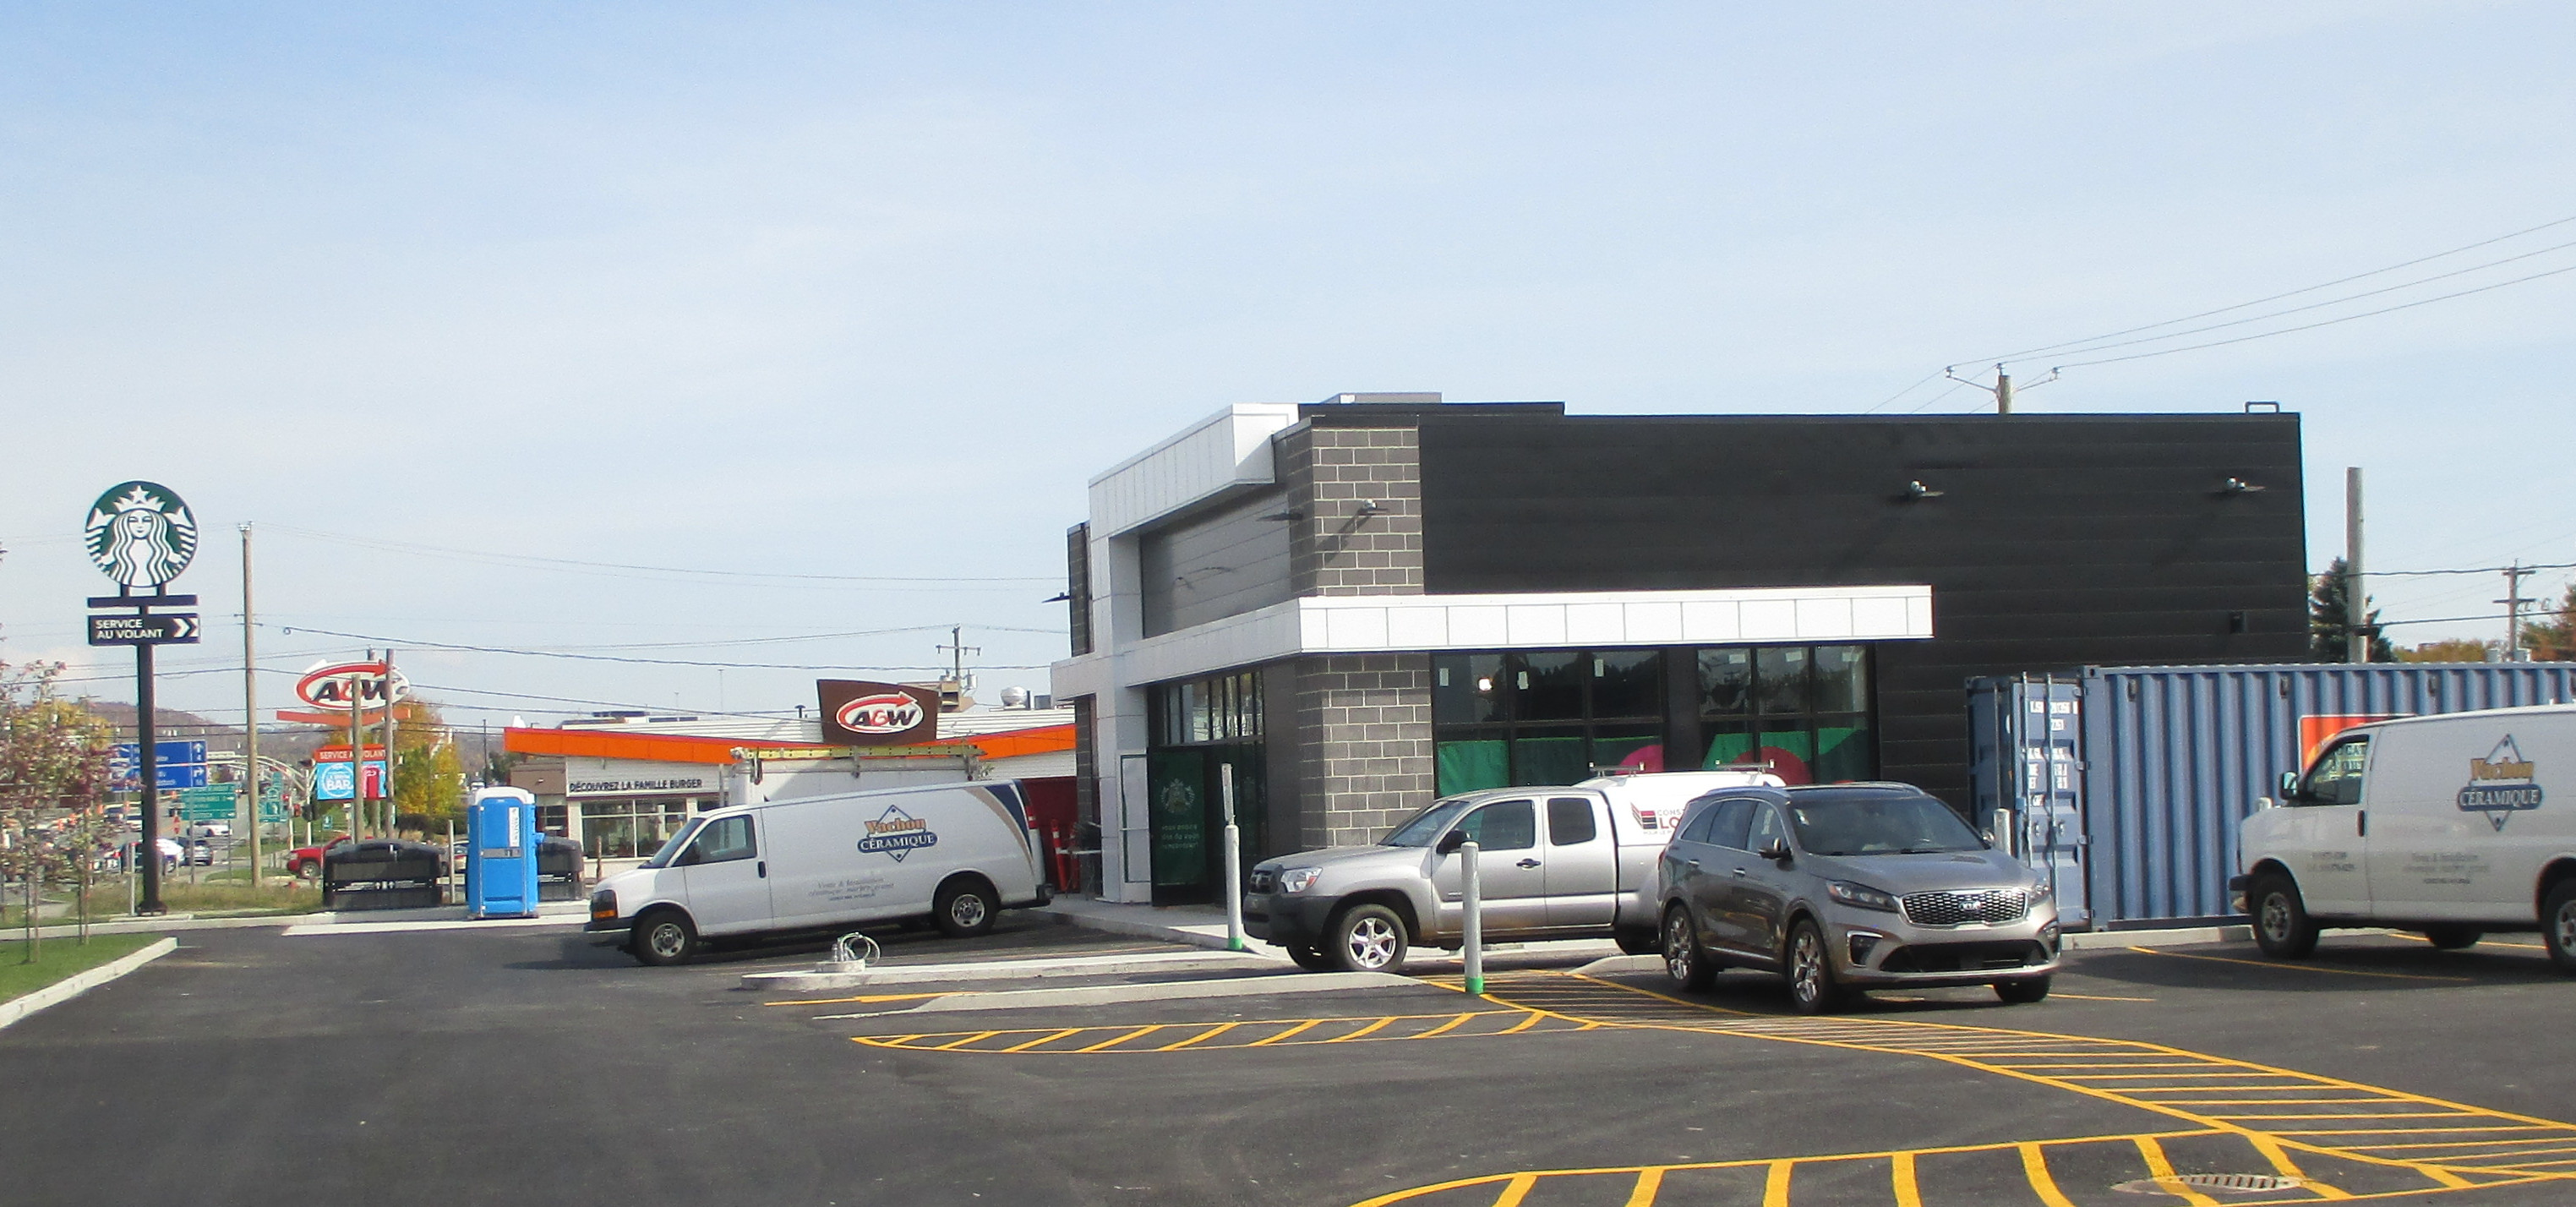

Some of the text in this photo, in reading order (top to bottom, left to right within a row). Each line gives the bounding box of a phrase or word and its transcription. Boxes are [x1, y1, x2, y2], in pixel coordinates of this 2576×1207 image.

[96, 619, 143, 629] SERVICE
[96, 629, 164, 639] AU VOLANT
[851, 708, 917, 727] A&W
[570, 778, 702, 792] DÉCOUVREZ LA FAMILLE BURGER
[2459, 788, 2540, 808] CÉRAMIQUE
[864, 817, 926, 834] Vachon
[860, 834, 935, 850] CÉRAMIQUE
